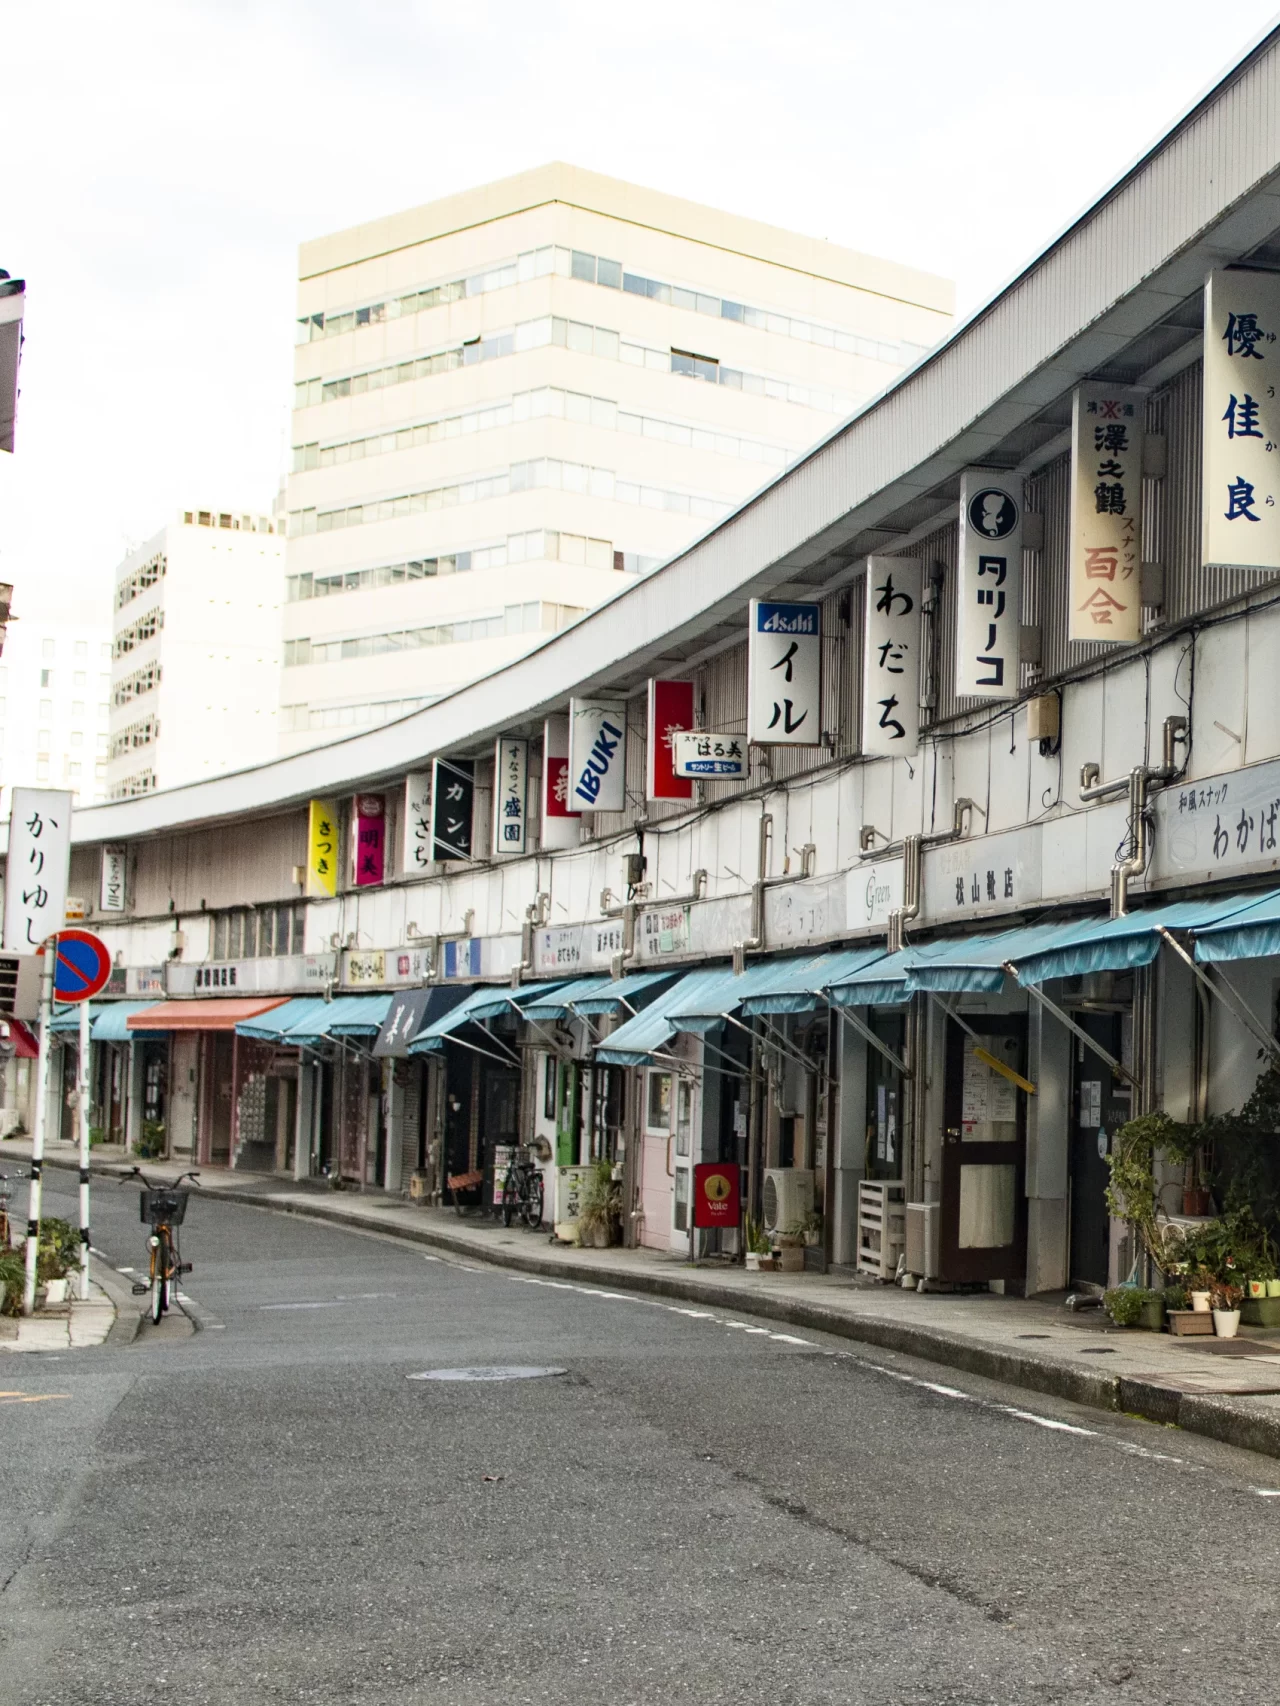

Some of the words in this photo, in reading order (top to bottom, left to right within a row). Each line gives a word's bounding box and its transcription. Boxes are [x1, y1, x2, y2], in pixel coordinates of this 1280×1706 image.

[1222, 312, 1265, 522] 優佳良
[1265, 332, 1278, 508] ゆうから
[1094, 424, 1129, 515] 澤之鶴
[1120, 517, 1136, 581] スナック
[1077, 546, 1128, 625] 百合
[763, 612, 813, 633] Asahi
[975, 555, 1007, 686] タツノコ
[767, 641, 808, 734] イル
[875, 573, 914, 739] わだち
[575, 720, 623, 805] IBUKI
[684, 735, 711, 743] スナック
[698, 740, 743, 758] はる美
[445, 782, 465, 834] カン
[1178, 783, 1229, 814] 和風スナック
[1213, 798, 1280, 860] わかば
[317, 820, 332, 875] さつき
[360, 829, 380, 876] 明美
[413, 817, 430, 868] さち
[23, 812, 59, 945] かりゆし
[955, 867, 1014, 906] 松山靴店
